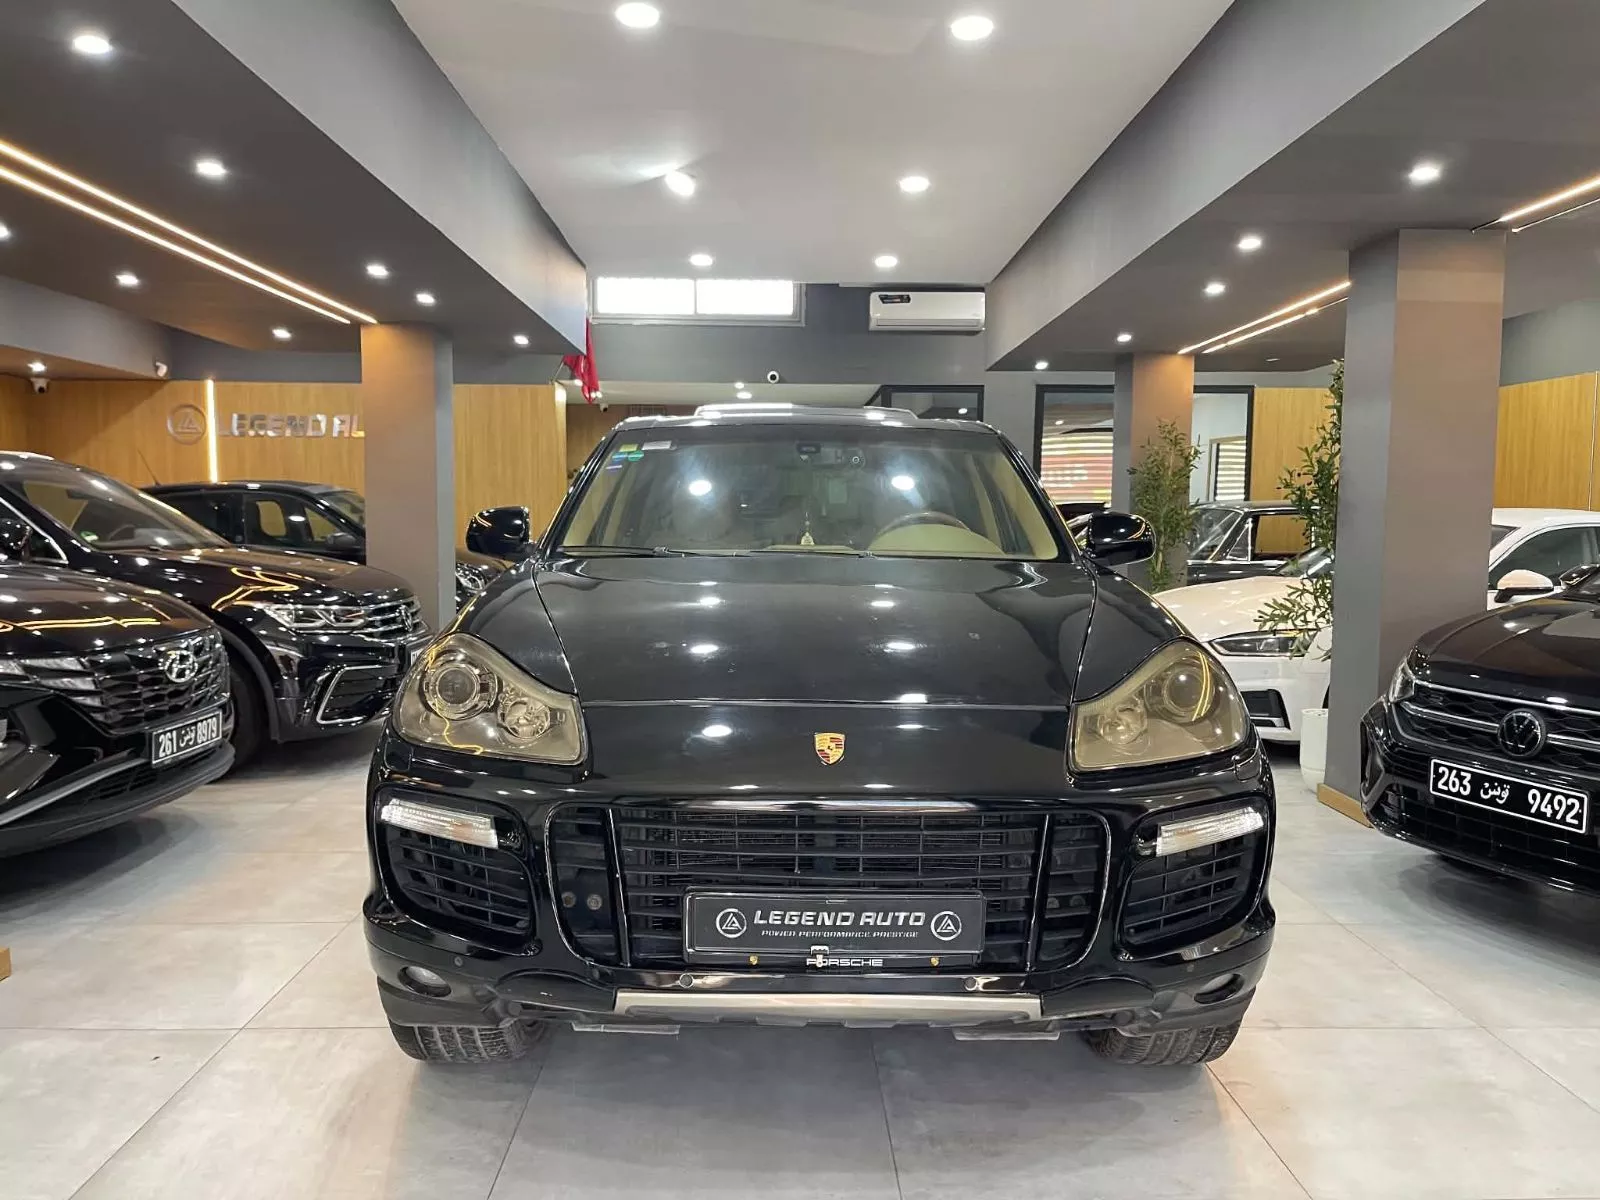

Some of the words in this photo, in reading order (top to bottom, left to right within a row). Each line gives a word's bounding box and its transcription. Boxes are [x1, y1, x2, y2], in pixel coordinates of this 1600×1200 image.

[159, 730, 177, 758] 261
[197, 717, 217, 744] 8979
[1437, 766, 1471, 796] 263
[1480, 782, 1511, 805] تونس
[1527, 788, 1580, 825] 9492
[753, 910, 855, 926] LEGEND
[859, 911, 926, 926] AUTO
